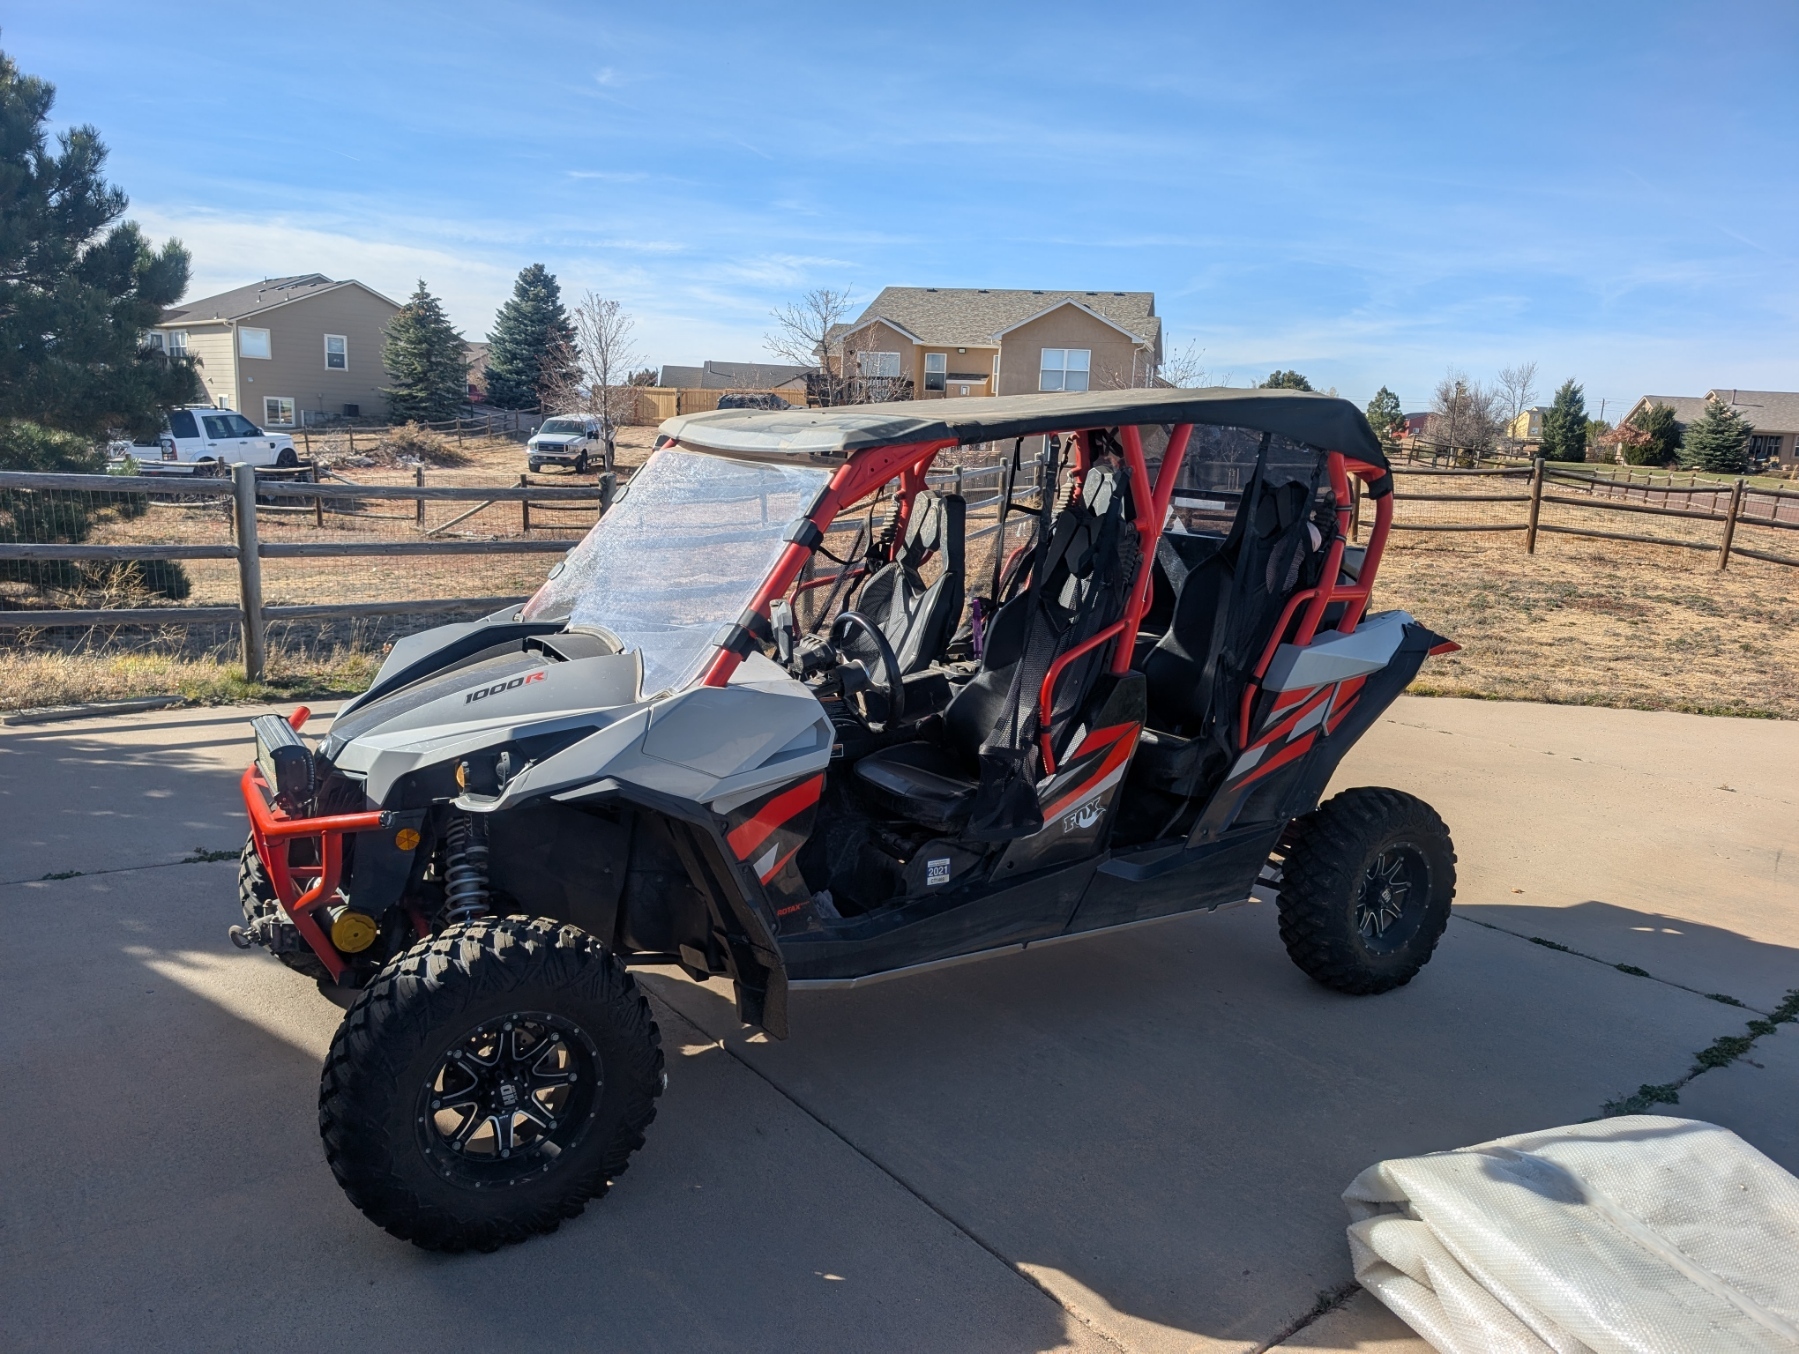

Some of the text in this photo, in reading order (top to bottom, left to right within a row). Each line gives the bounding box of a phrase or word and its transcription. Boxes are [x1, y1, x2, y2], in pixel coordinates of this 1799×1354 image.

[466, 671, 545, 705] 1000R
[1064, 796, 1104, 833] FOX
[928, 865, 948, 877] 2021
[776, 903, 801, 917] ROTAX
